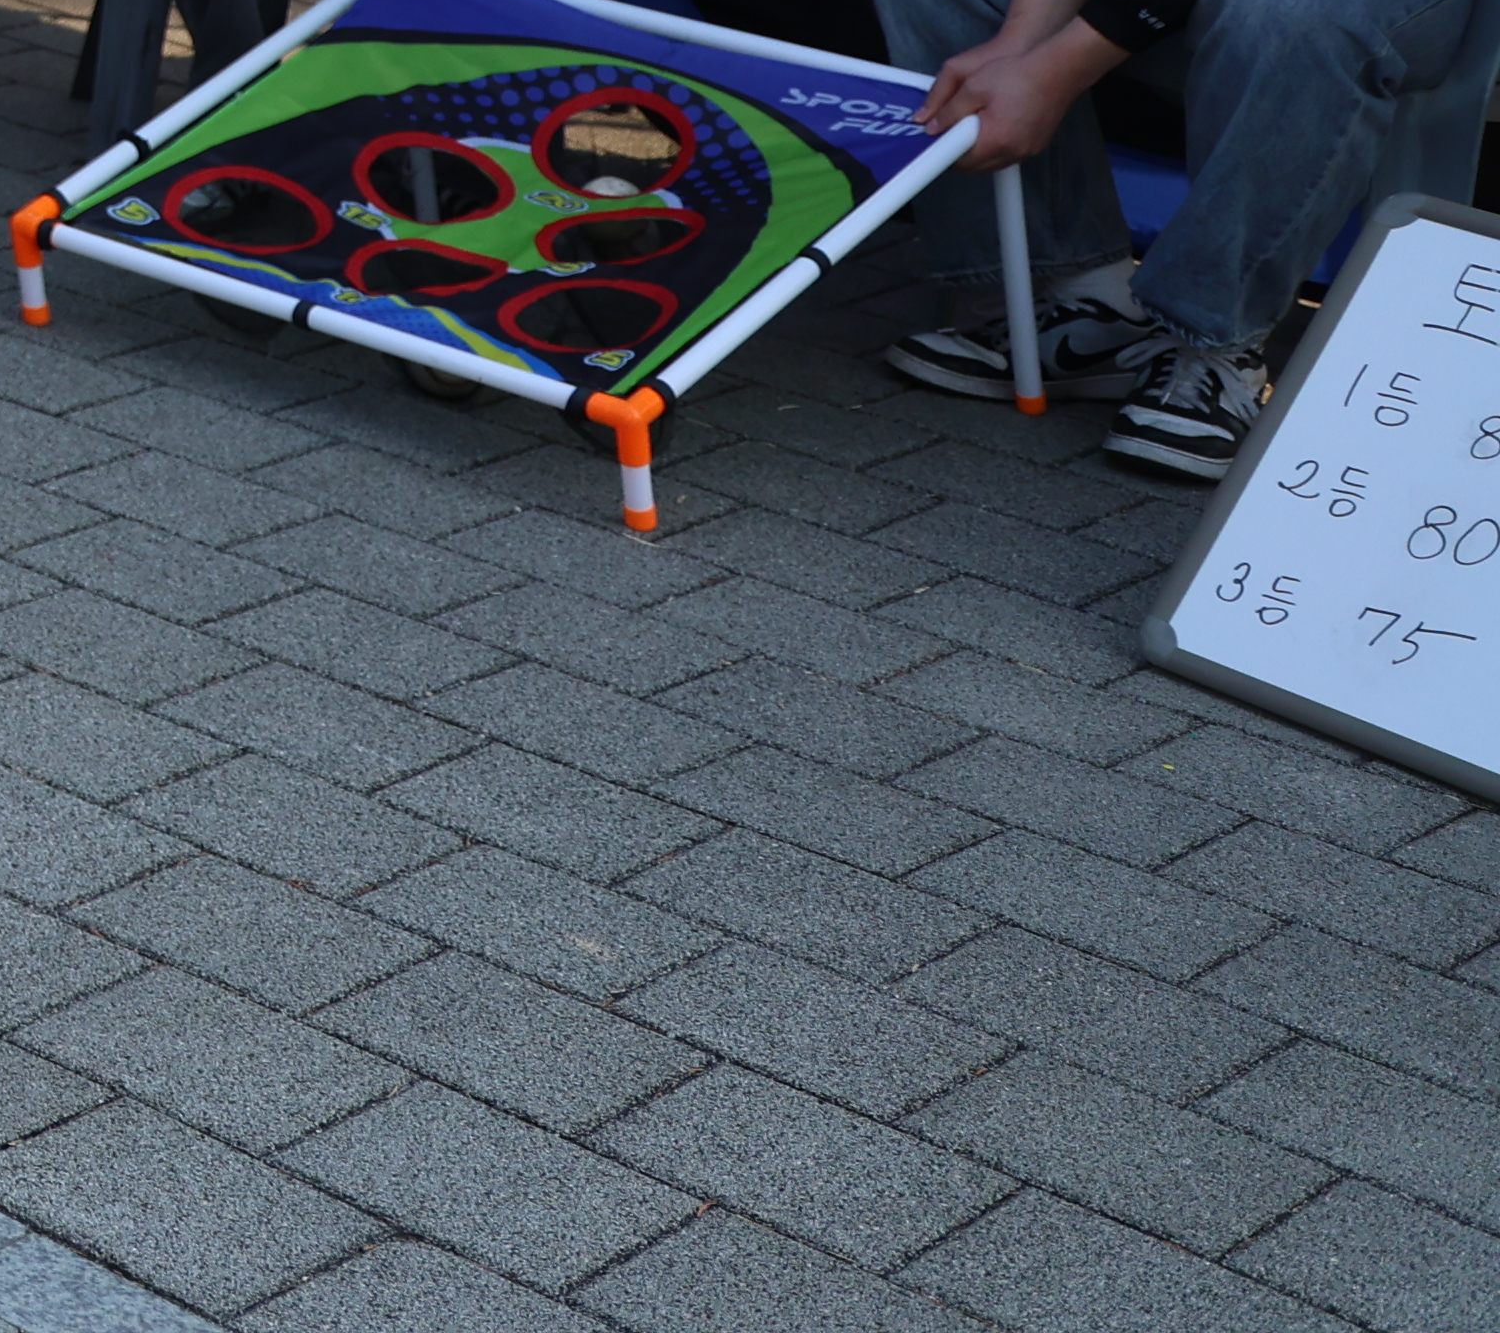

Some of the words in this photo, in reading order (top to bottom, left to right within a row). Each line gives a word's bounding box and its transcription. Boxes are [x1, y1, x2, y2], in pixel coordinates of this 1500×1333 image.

[779, 87, 922, 123] SPOR
[1343, 363, 1421, 427] 1등
[1277, 459, 1369, 517] 2등
[1406, 505, 1500, 566] 80
[1216, 562, 1301, 625] 3등
[1357, 606, 1477, 665] 75
